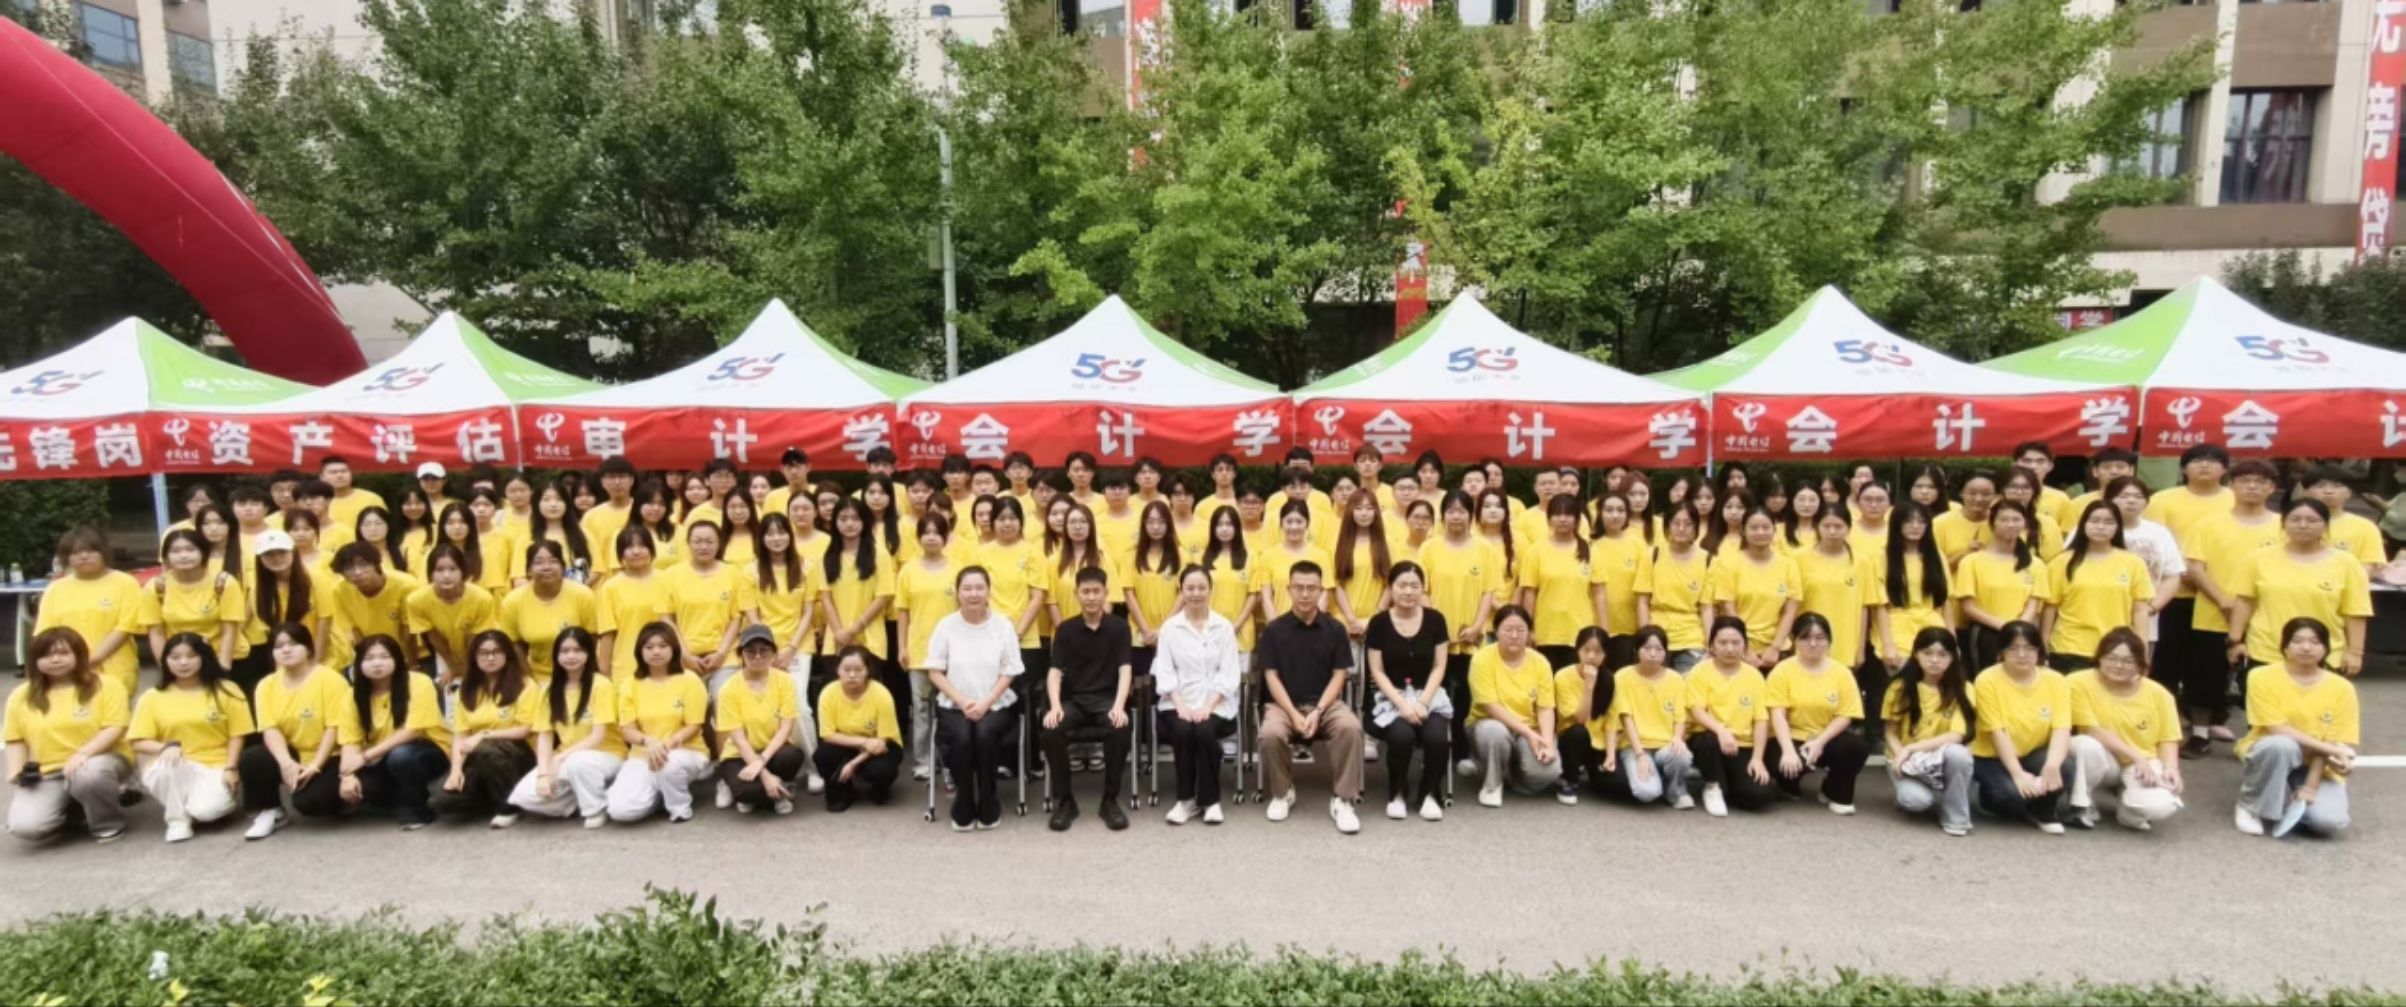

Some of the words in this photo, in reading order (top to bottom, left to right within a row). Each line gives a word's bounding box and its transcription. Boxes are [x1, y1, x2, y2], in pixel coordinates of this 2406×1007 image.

[707, 357, 776, 381] 5G
[1071, 353, 1143, 383] 5G
[1446, 346, 1518, 372] 5G
[208, 417, 505, 466] 资产评估
[581, 413, 889, 463] 审计学
[960, 410, 1280, 460] 会计学
[1363, 408, 1696, 461] 会计学
[1786, 395, 2131, 453] 会计学
